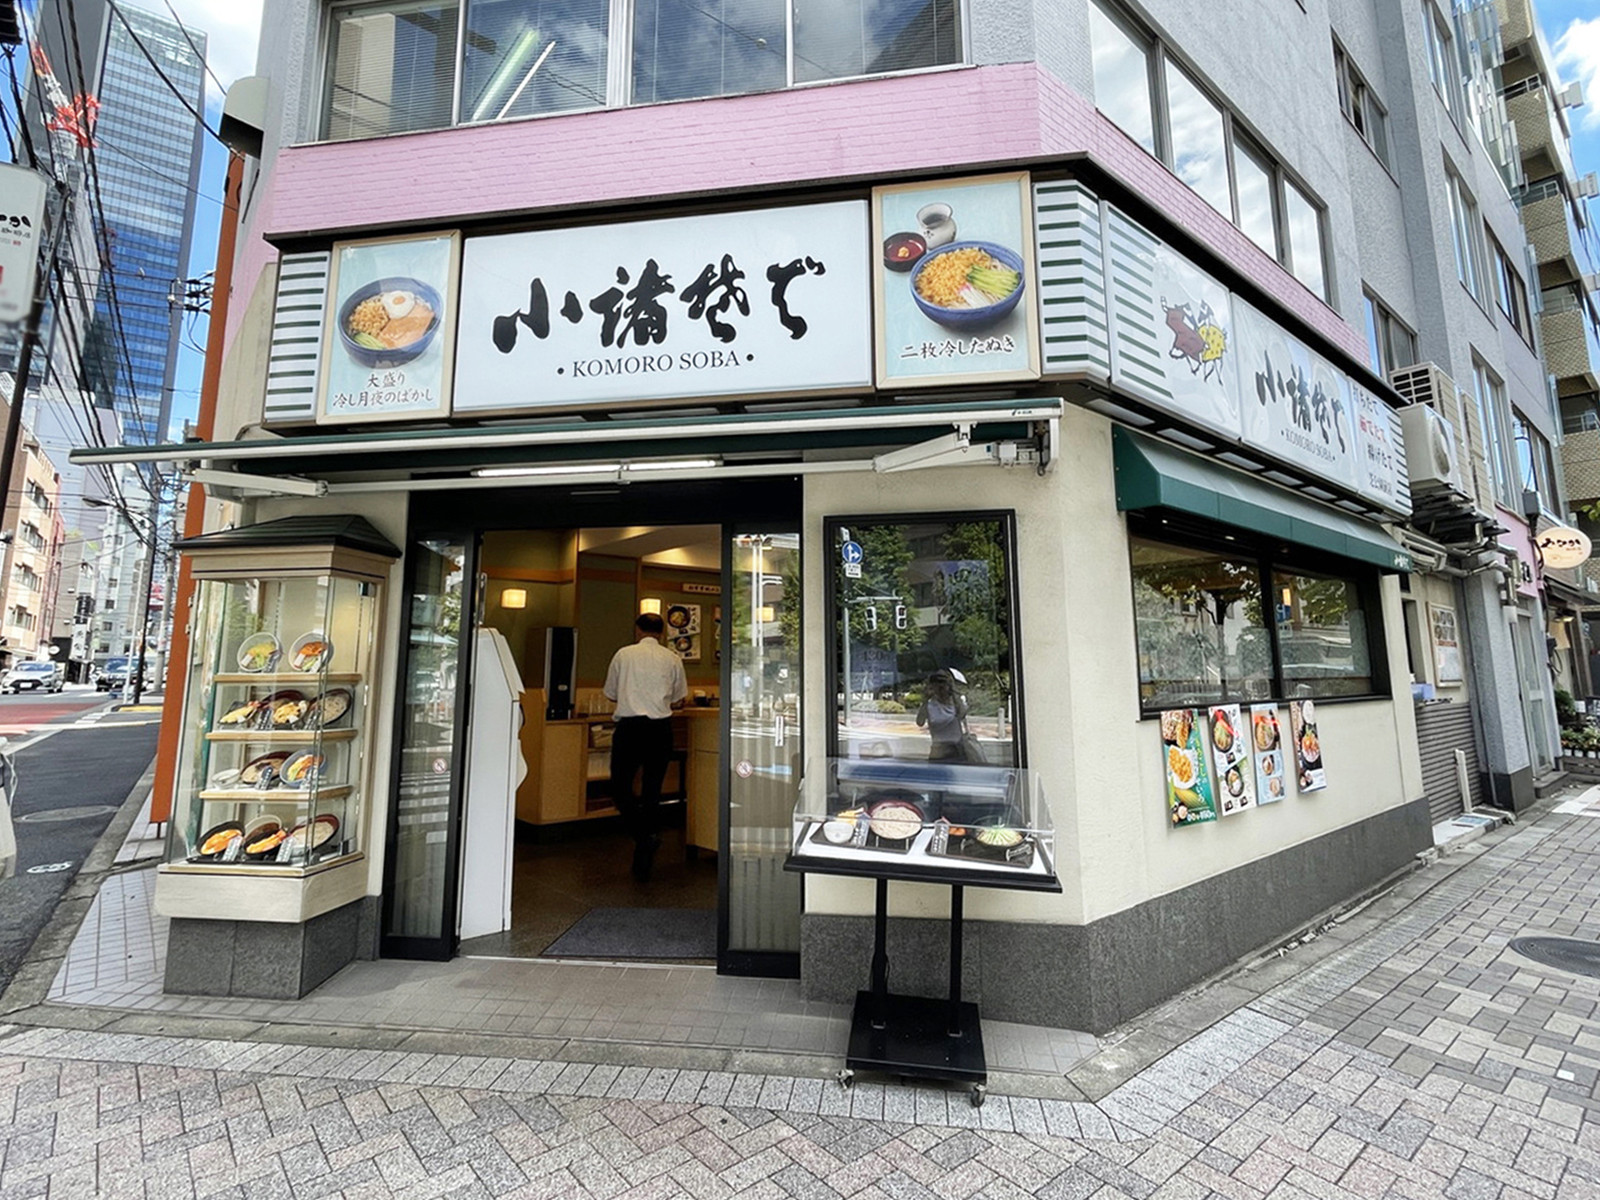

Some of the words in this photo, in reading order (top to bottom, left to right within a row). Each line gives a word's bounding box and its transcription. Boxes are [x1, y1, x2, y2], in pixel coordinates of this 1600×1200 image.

[901, 336, 1014, 359] 二枚冷したぬき
[572, 354, 673, 378] KOMORO
[679, 349, 741, 371] SOBA
[367, 371, 405, 388] 大盛り
[332, 387, 433, 408] 冷し月夜のばかし
[1285, 428, 1315, 454] KOMORO
[1315, 443, 1333, 463] SOBA
